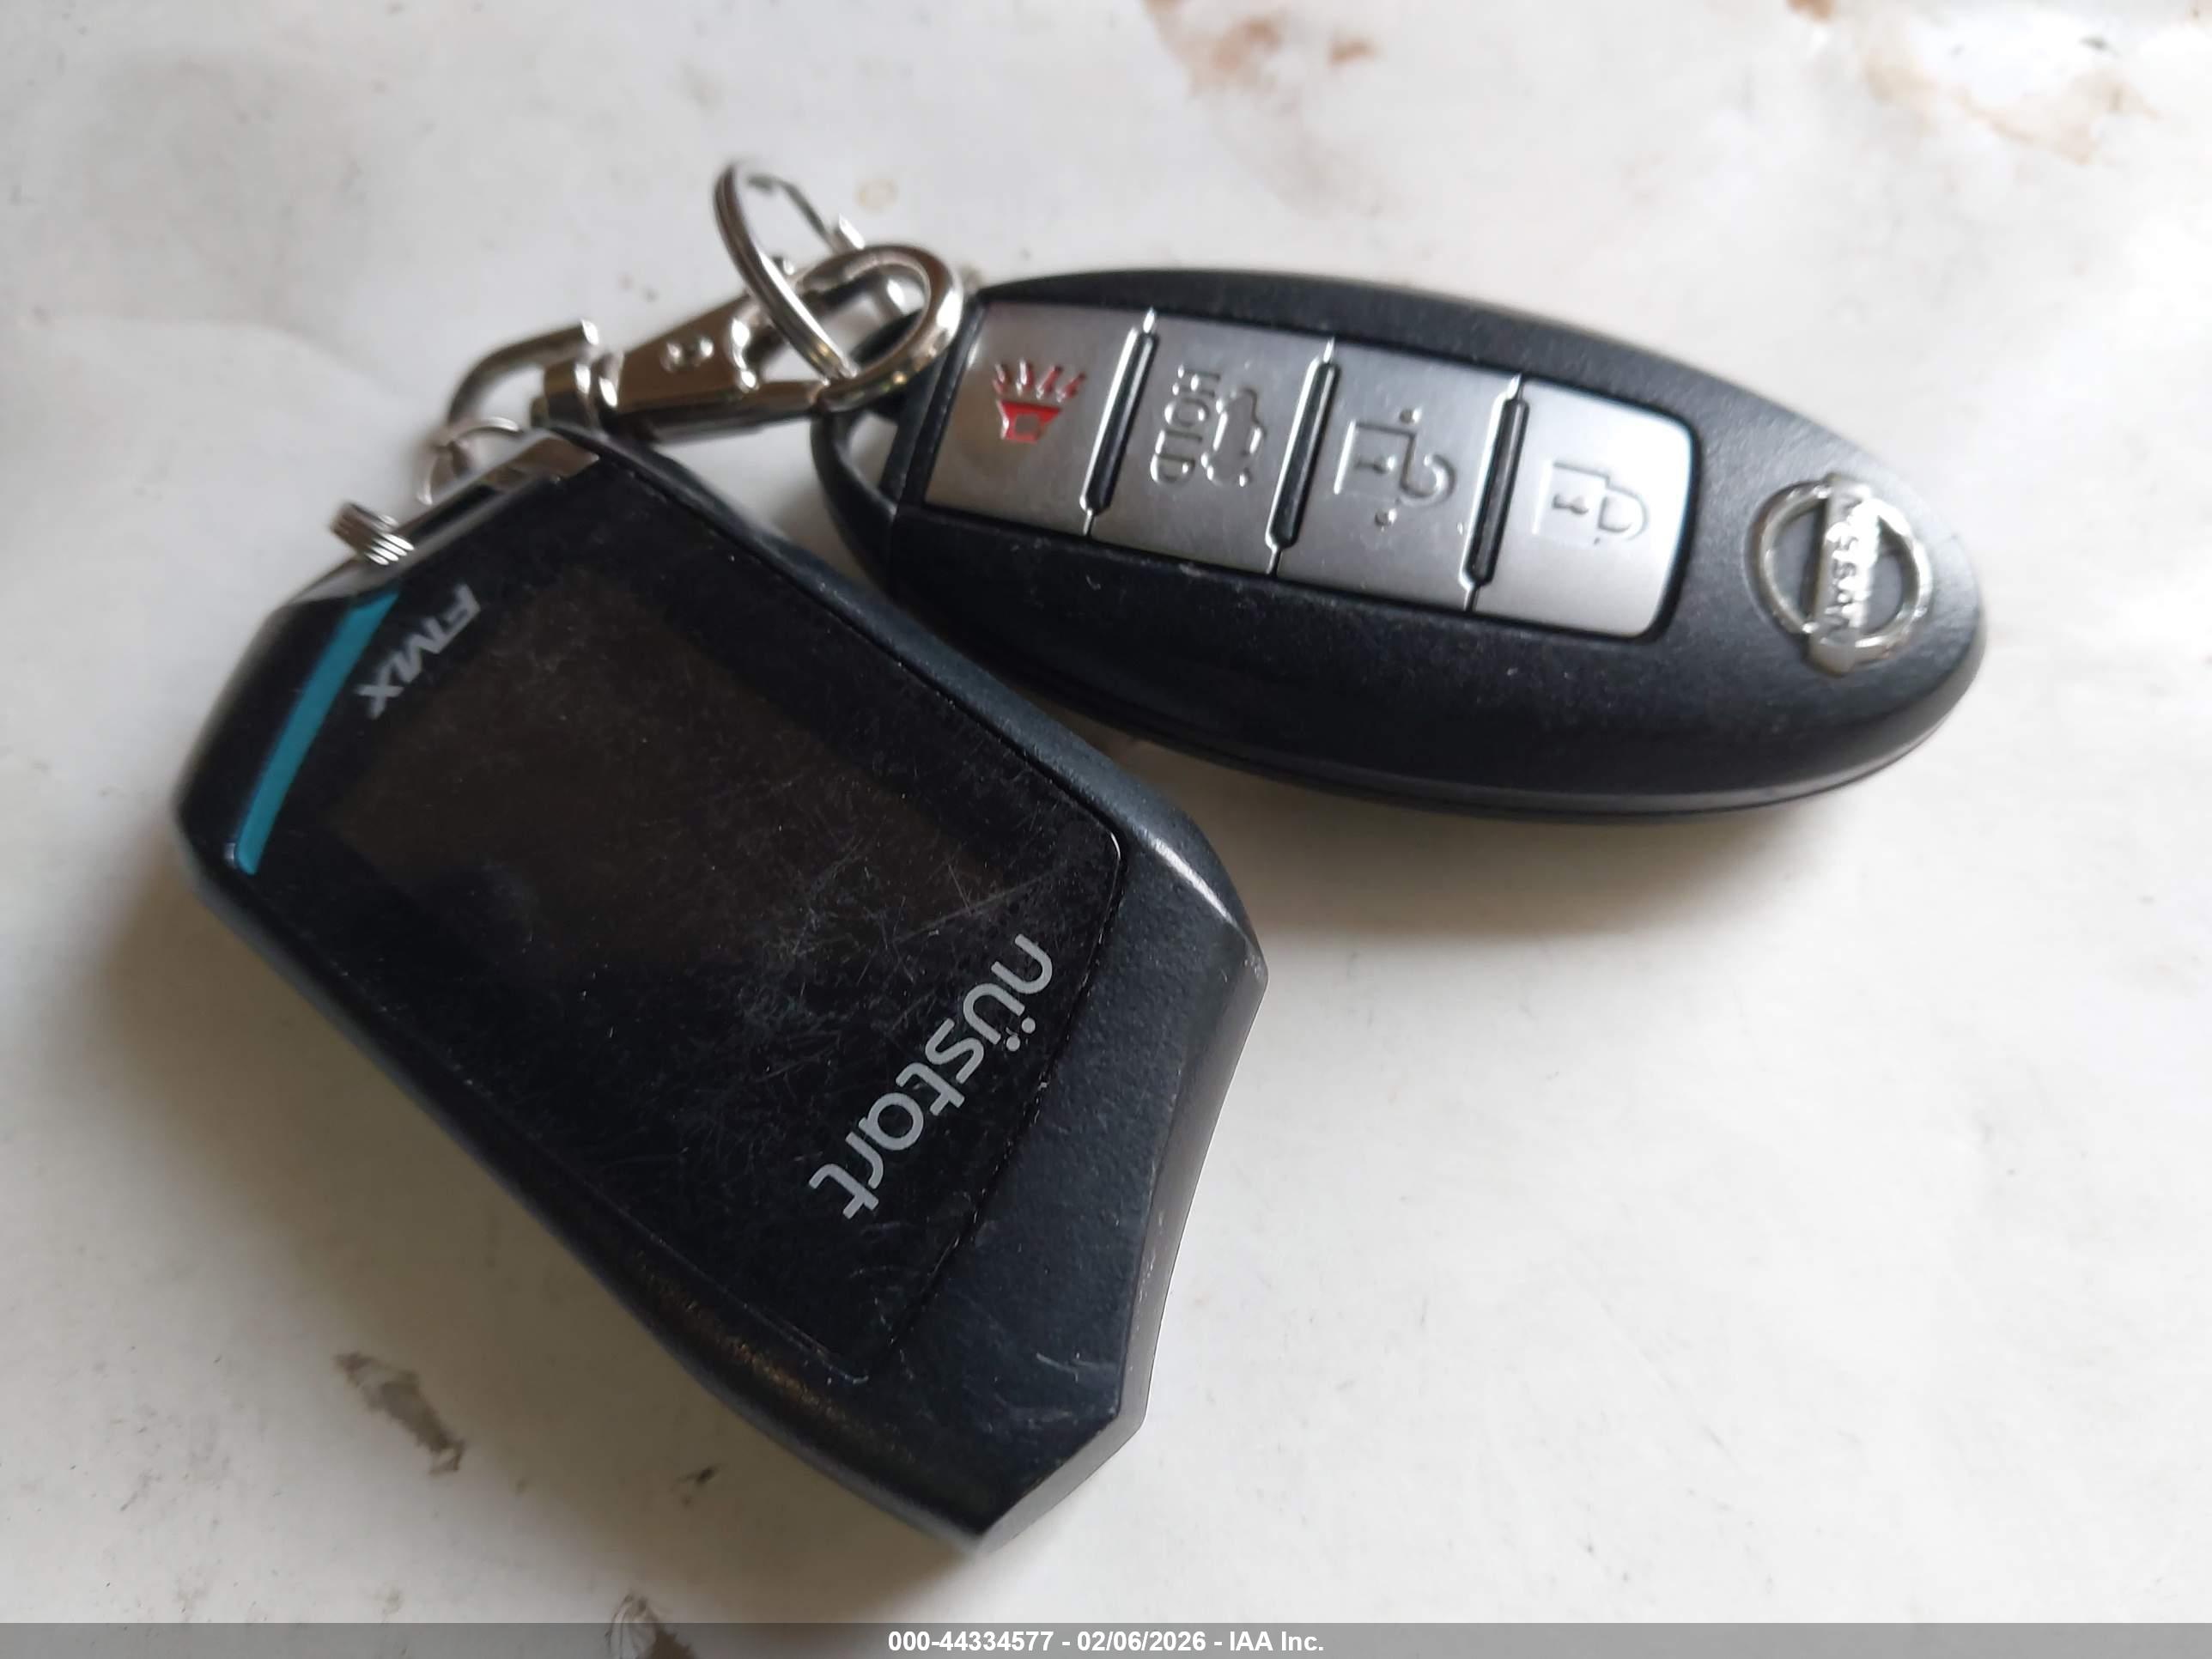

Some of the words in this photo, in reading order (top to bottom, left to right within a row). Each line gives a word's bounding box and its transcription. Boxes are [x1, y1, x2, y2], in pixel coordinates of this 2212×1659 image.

[1149, 364, 1220, 486] HOLD
[354, 583, 482, 720] FMX
[809, 933, 1053, 1219] nüstart
